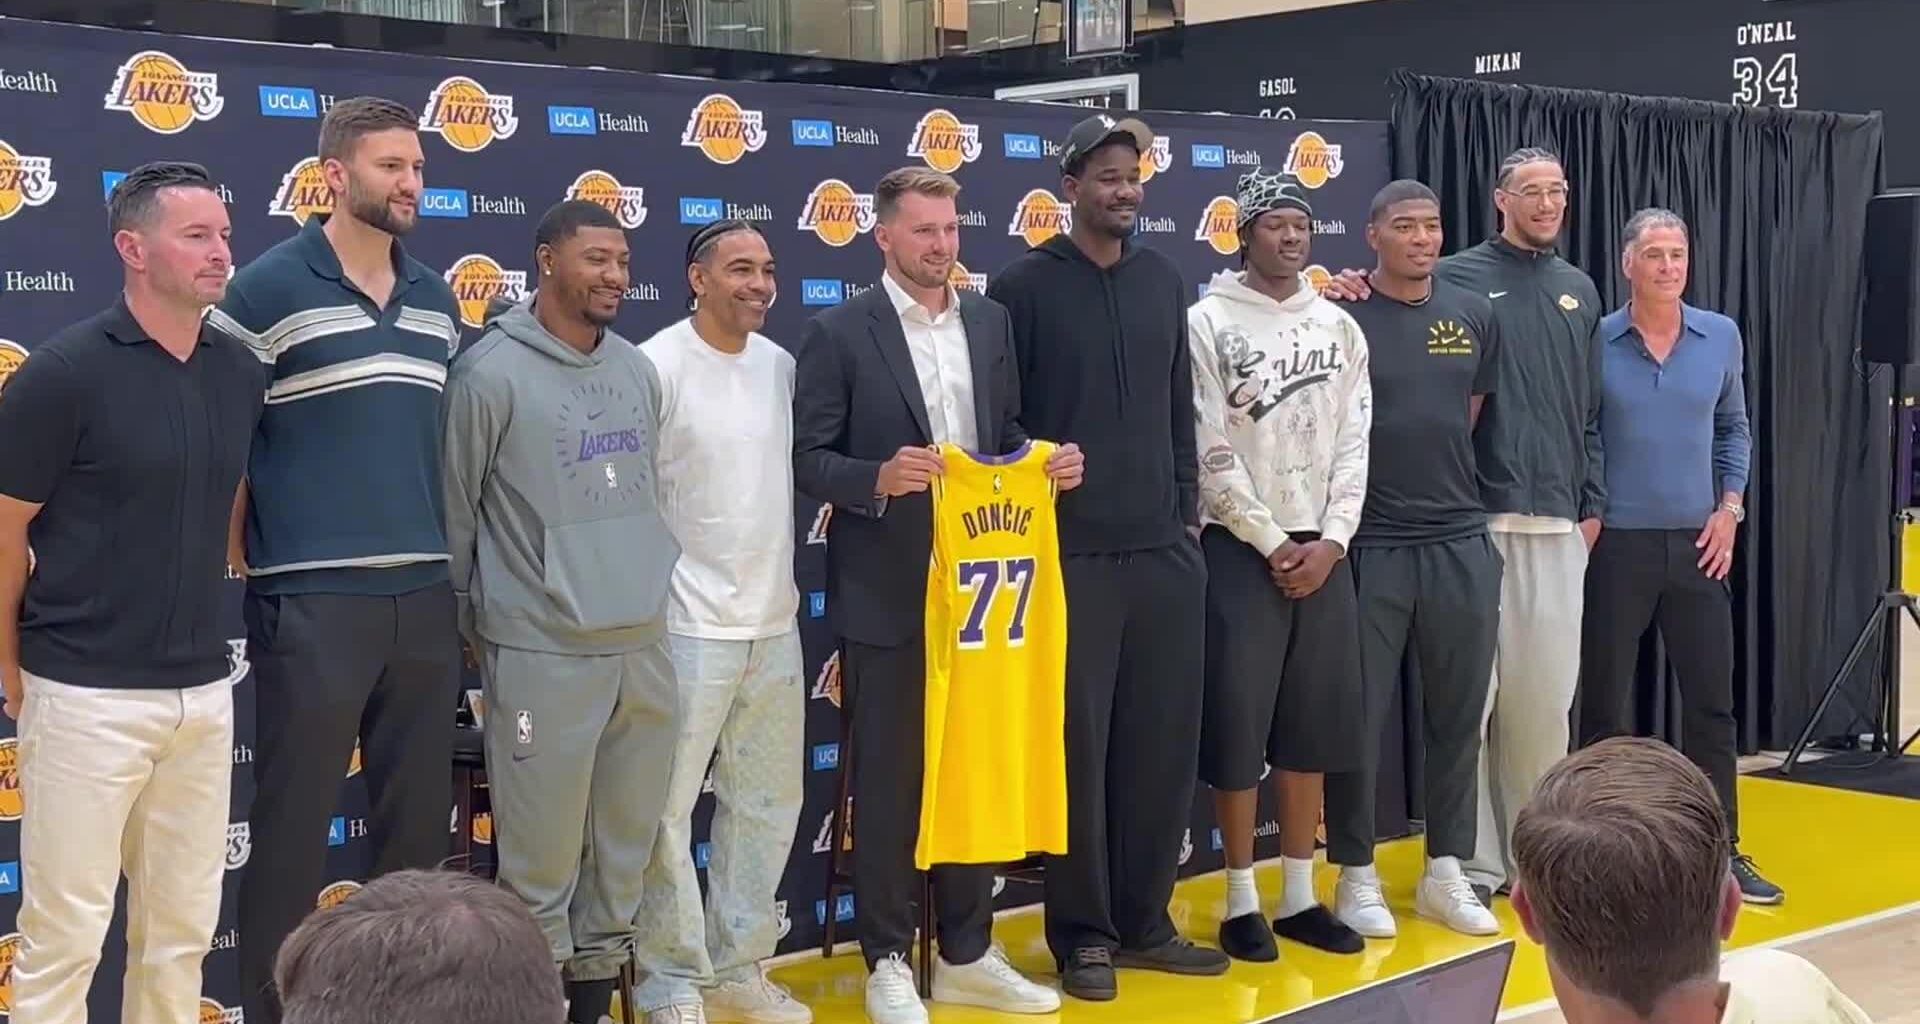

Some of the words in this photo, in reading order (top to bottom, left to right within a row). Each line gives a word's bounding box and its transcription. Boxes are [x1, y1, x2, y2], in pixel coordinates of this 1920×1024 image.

[1737, 20, 1796, 45] O'NEAL
[1475, 51, 1521, 74] MIKAN
[1259, 77, 1297, 97] GASOL
[1732, 52, 1798, 109] 34
[115, 70, 216, 117] LAKERS
[268, 94, 309, 110] UCLA
[428, 95, 512, 134] LAKERS
[555, 112, 590, 128] UCLA
[599, 112, 649, 133] Health
[688, 112, 764, 149] LAKERS
[798, 125, 828, 140] UCLA
[835, 125, 880, 145] Health
[915, 125, 979, 160] LAKERS
[1009, 140, 1036, 153] UCLA
[0, 159, 45, 168] NGELES
[1196, 150, 1220, 162] UCLA
[1226, 149, 1261, 165] Health
[1290, 146, 1340, 175] LAKERS
[424, 195, 461, 210] UCLA
[472, 194, 527, 216] Health
[685, 204, 718, 217] UCLA
[726, 203, 773, 221] Health
[805, 196, 873, 231] LAKERS
[955, 210, 987, 227] ealth
[1015, 205, 1072, 234] LAKERS
[1140, 217, 1176, 233] Health
[1201, 211, 1237, 237] LAKE
[1312, 219, 1346, 235] Health
[5, 270, 75, 292] Health
[622, 283, 660, 301] ealth
[807, 286, 837, 298] UCLA
[577, 428, 641, 462] LAKERS
[961, 498, 1035, 540] DONČIĆ
[957, 555, 1037, 650] 77
[1253, 820, 1280, 838] ealth
